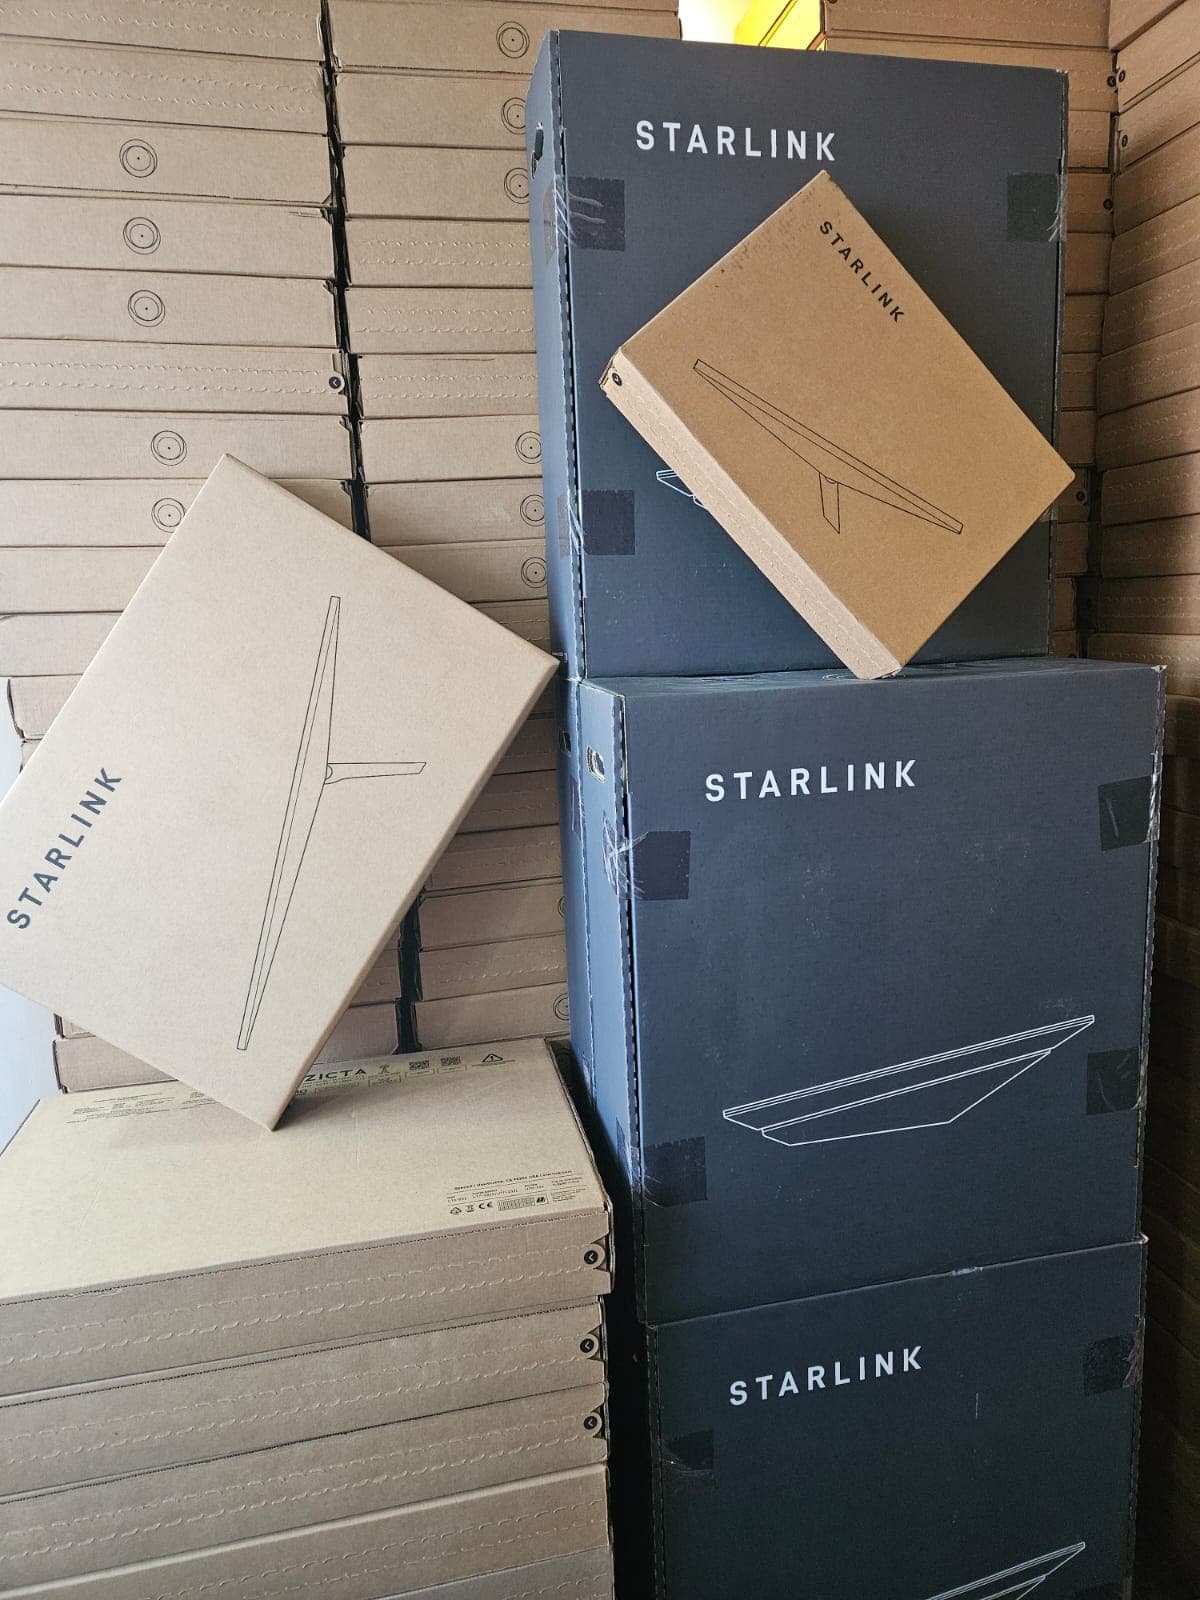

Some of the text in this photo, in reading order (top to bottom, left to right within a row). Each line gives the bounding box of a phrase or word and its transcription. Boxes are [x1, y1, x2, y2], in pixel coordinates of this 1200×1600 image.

[636, 120, 836, 161] STARLINK
[819, 220, 905, 323] STARLINK
[705, 759, 916, 802] STARLINK
[6, 767, 122, 930] STARLINK
[305, 1068, 367, 1082] ZICTA
[729, 1345, 922, 1406] STARLINK
